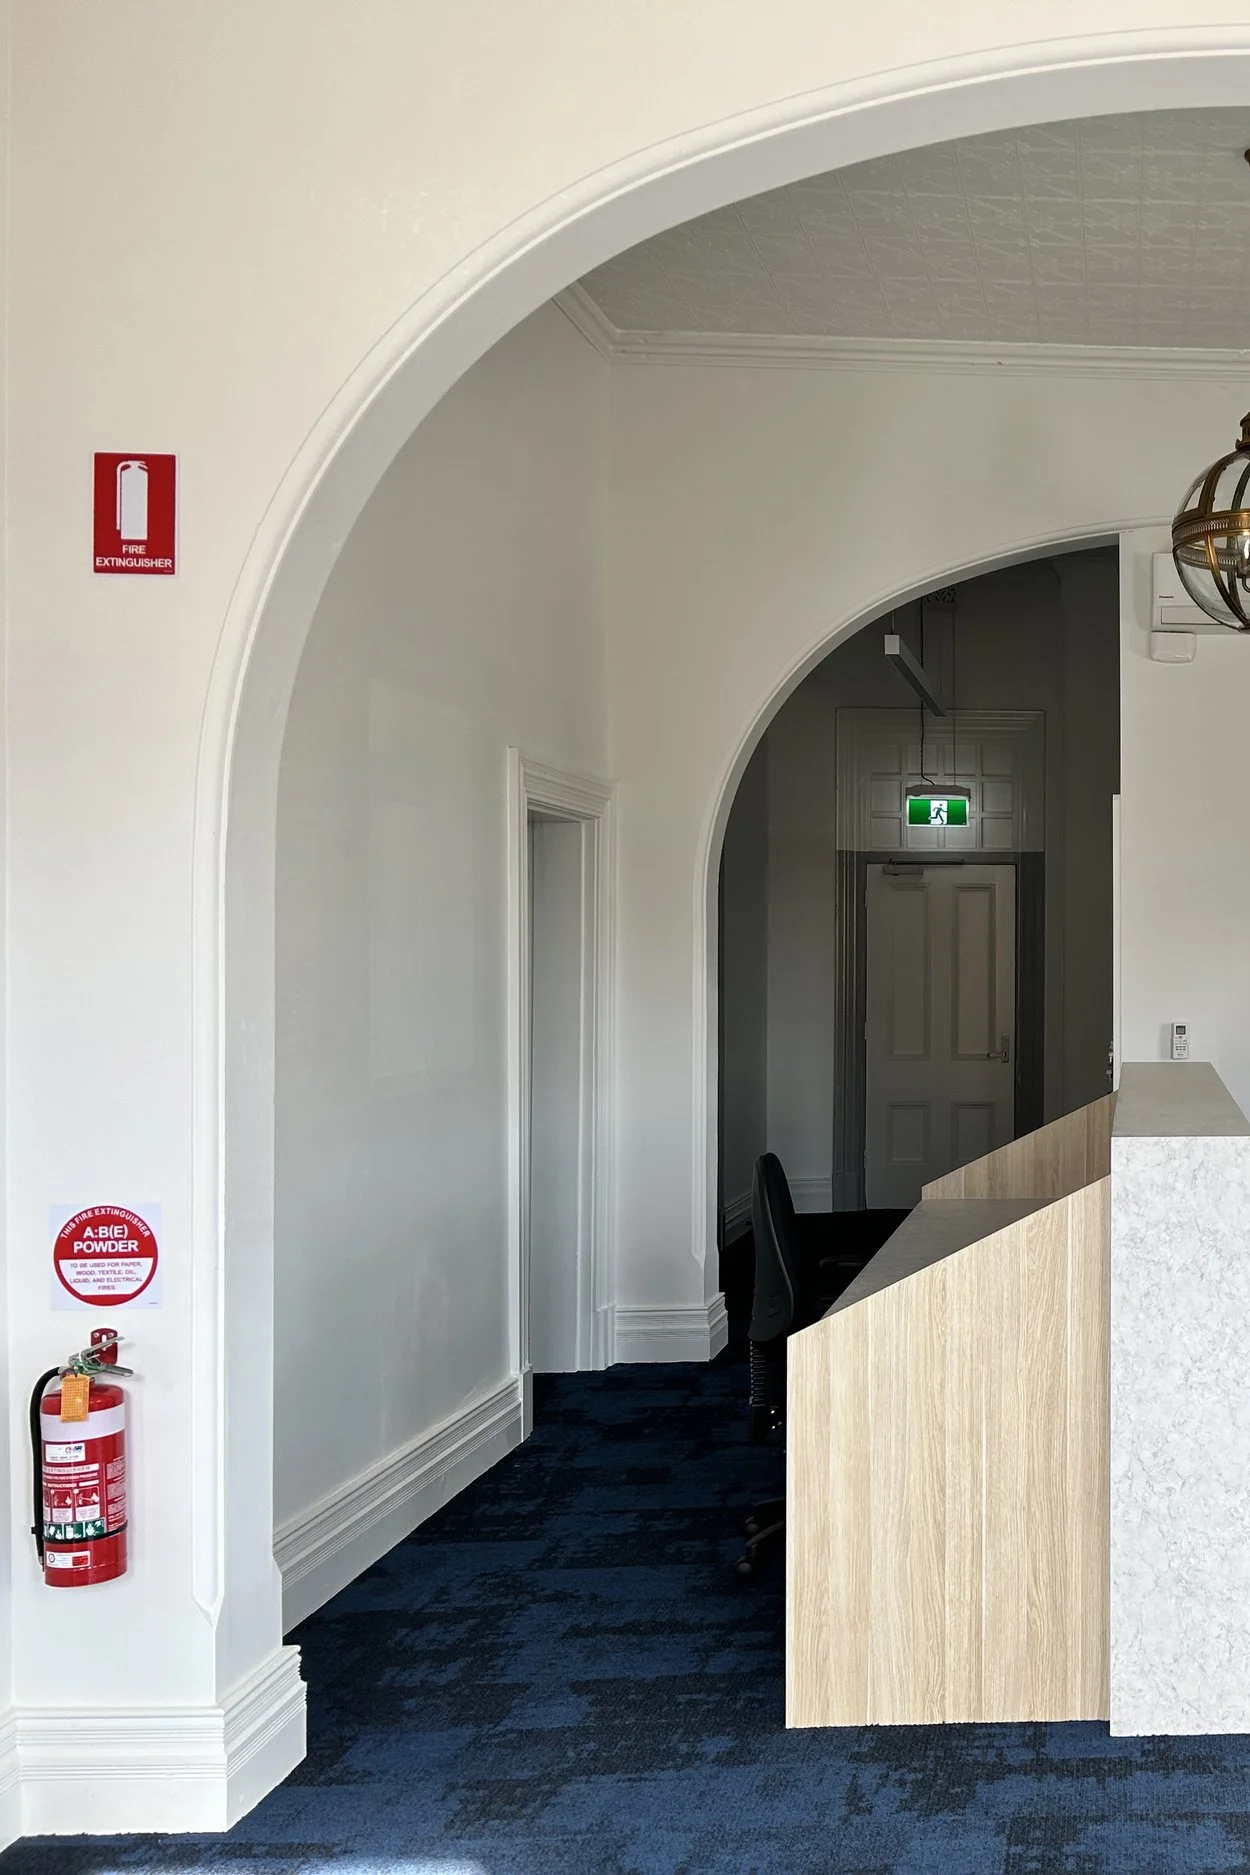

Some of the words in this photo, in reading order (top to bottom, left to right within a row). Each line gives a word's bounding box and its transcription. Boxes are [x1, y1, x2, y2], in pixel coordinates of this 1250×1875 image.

[122, 545, 146, 555] FIRE
[95, 557, 172, 568] EXTINGUISHER
[60, 1222, 76, 1239] THIS
[75, 1211, 94, 1224] FIRE
[94, 1207, 151, 1238] EXTINGUISHER
[83, 1224, 128, 1239] A:B(E)
[73, 1240, 139, 1254] POWDER
